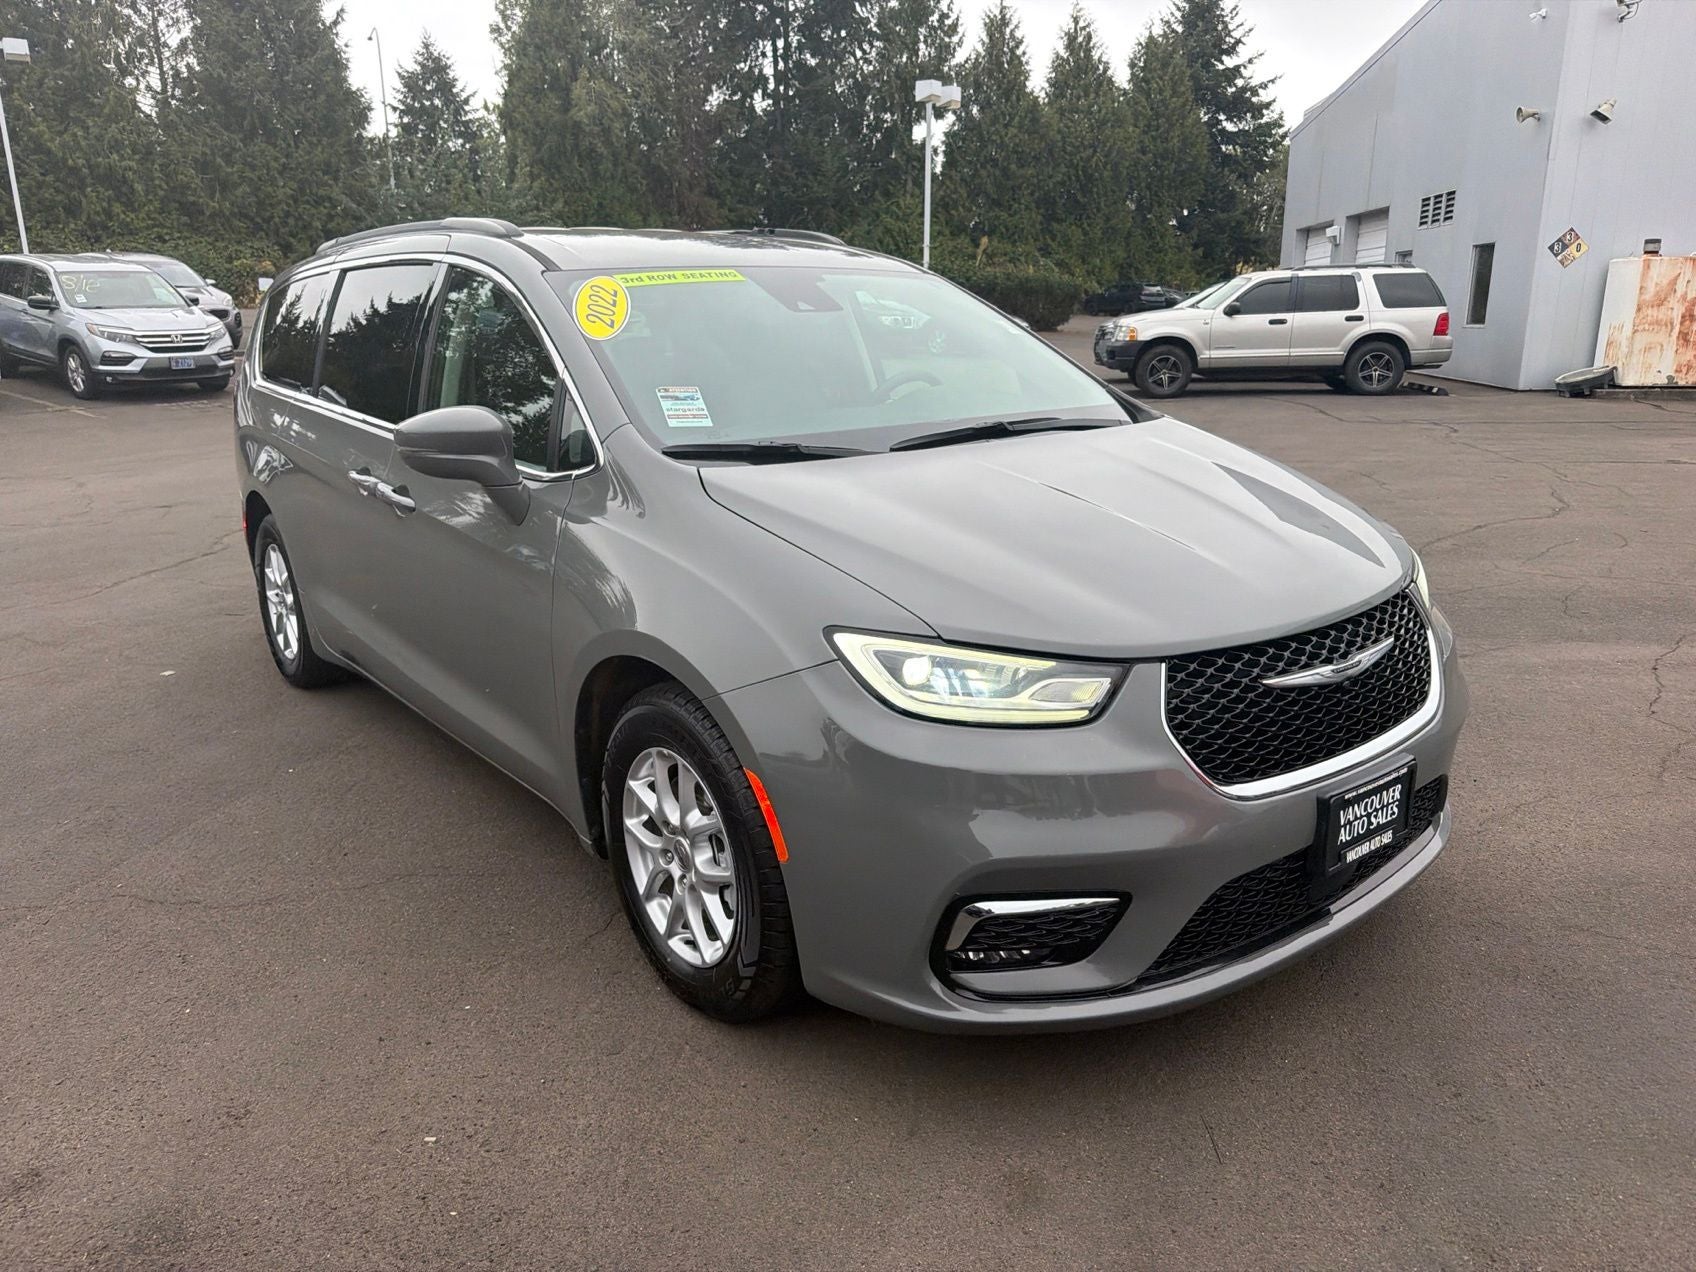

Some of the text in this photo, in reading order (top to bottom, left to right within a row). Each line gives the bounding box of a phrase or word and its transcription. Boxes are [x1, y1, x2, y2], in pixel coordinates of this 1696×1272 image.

[1554, 242, 1582, 253] 3 0
[1566, 231, 1573, 242] 3
[620, 271, 738, 284] 3rd ROW SEATING
[586, 285, 618, 329] 2022
[1340, 784, 1402, 826] VANCOUVER
[1337, 801, 1399, 845] AUTO SALES
